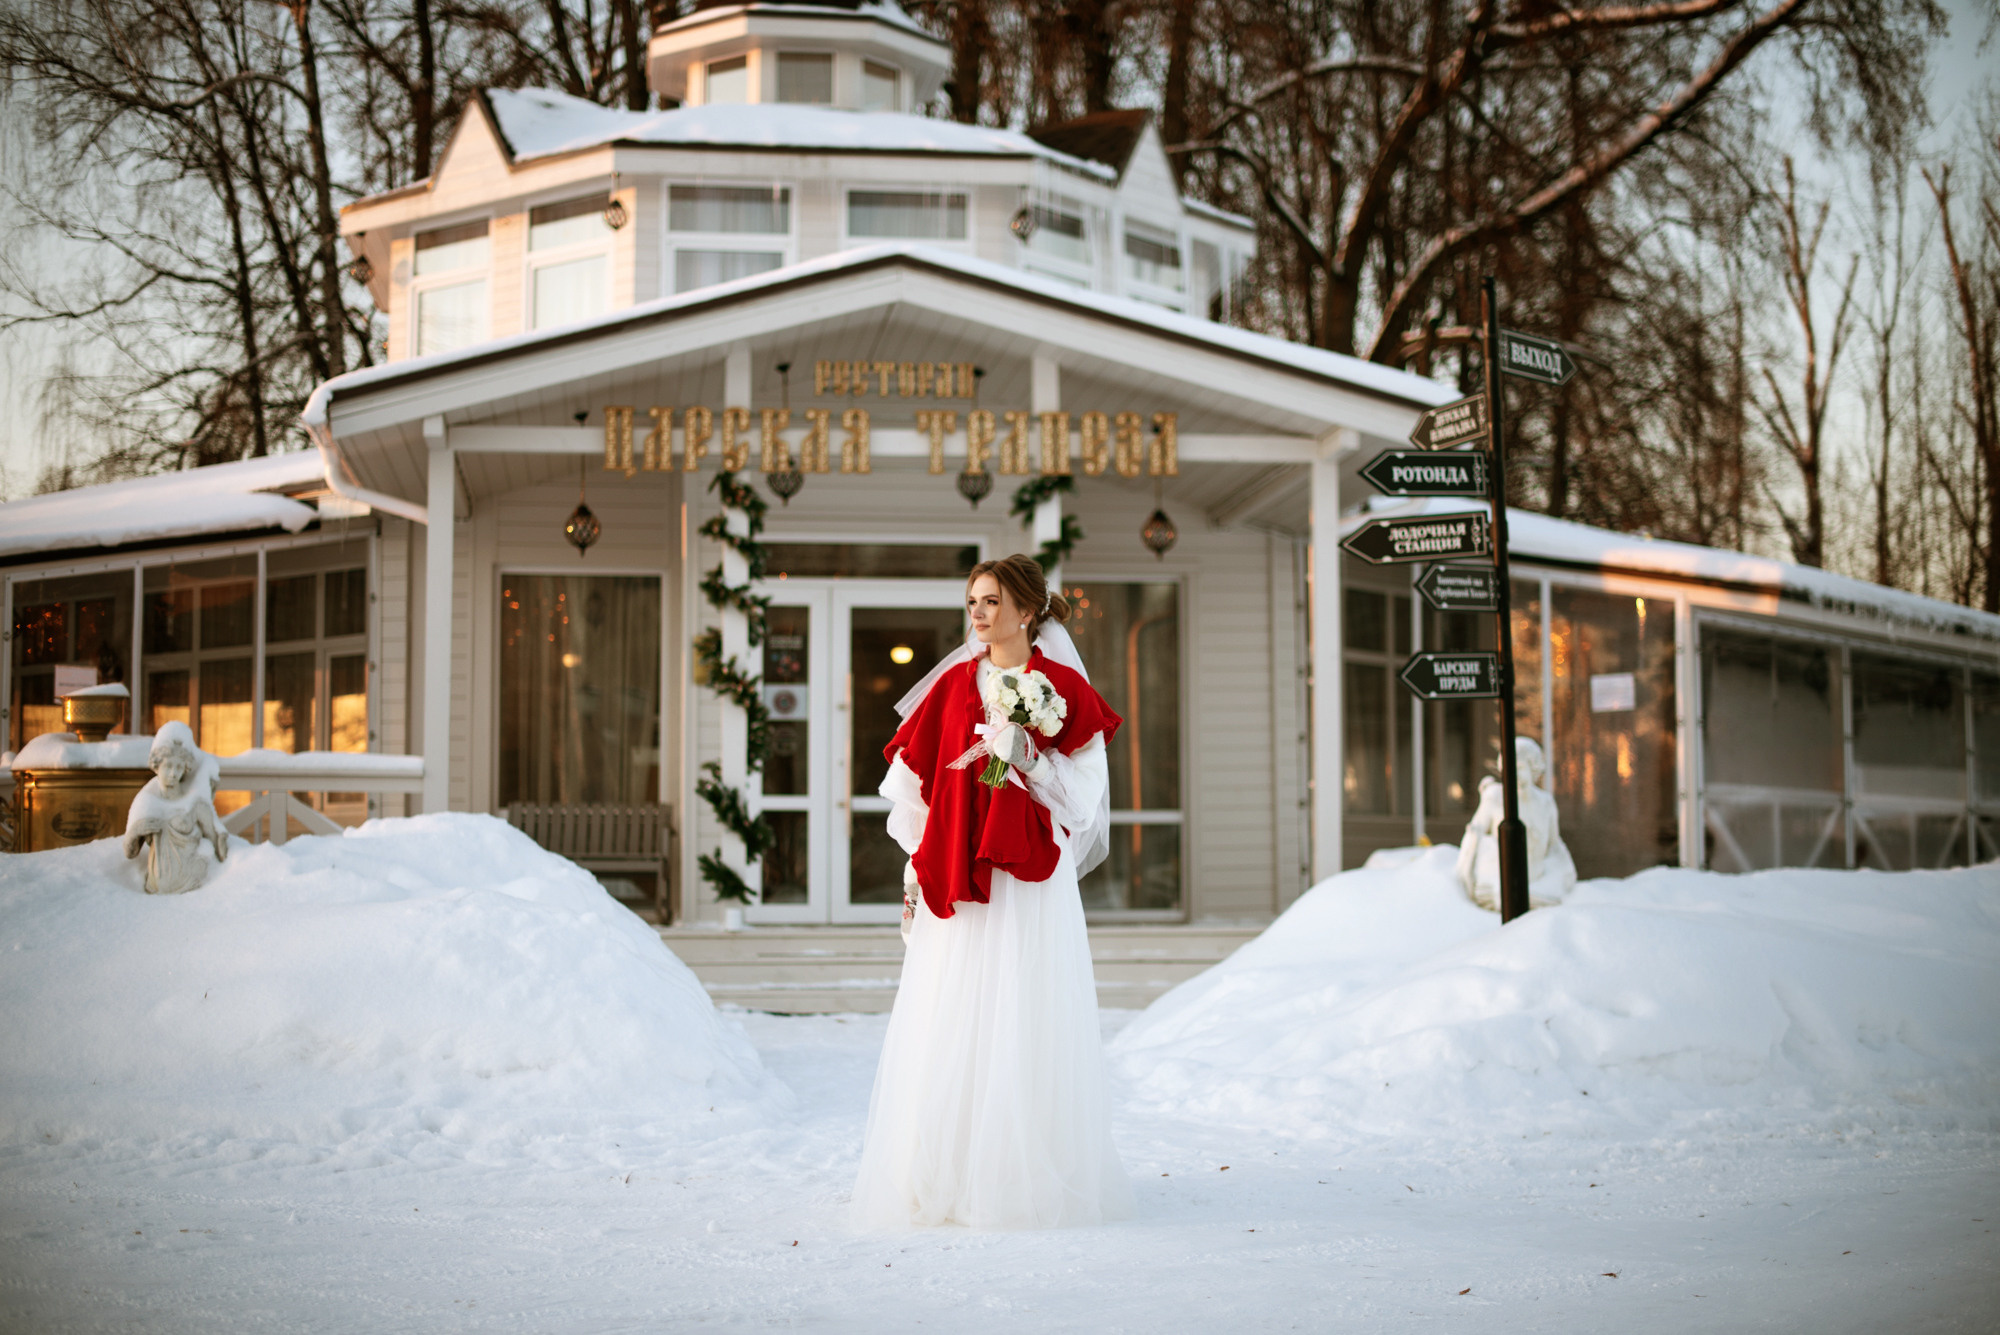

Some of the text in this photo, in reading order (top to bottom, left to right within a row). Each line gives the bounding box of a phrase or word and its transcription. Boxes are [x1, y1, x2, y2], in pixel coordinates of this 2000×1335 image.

[1511, 341, 1563, 378] ВЫХОД
[814, 360, 975, 398] РЕСТОРАН
[603, 405, 1179, 479] ЦАРСКАЯ ТРАПЕЗА
[1392, 466, 1469, 486] РОТОНДА
[1388, 522, 1467, 542] ЛОДОЧНАЯ
[1394, 537, 1462, 554] СТАНЦИЯ
[1433, 661, 1481, 676] БАРСКИЕ
[1439, 676, 1477, 692] ПРУДЫ
